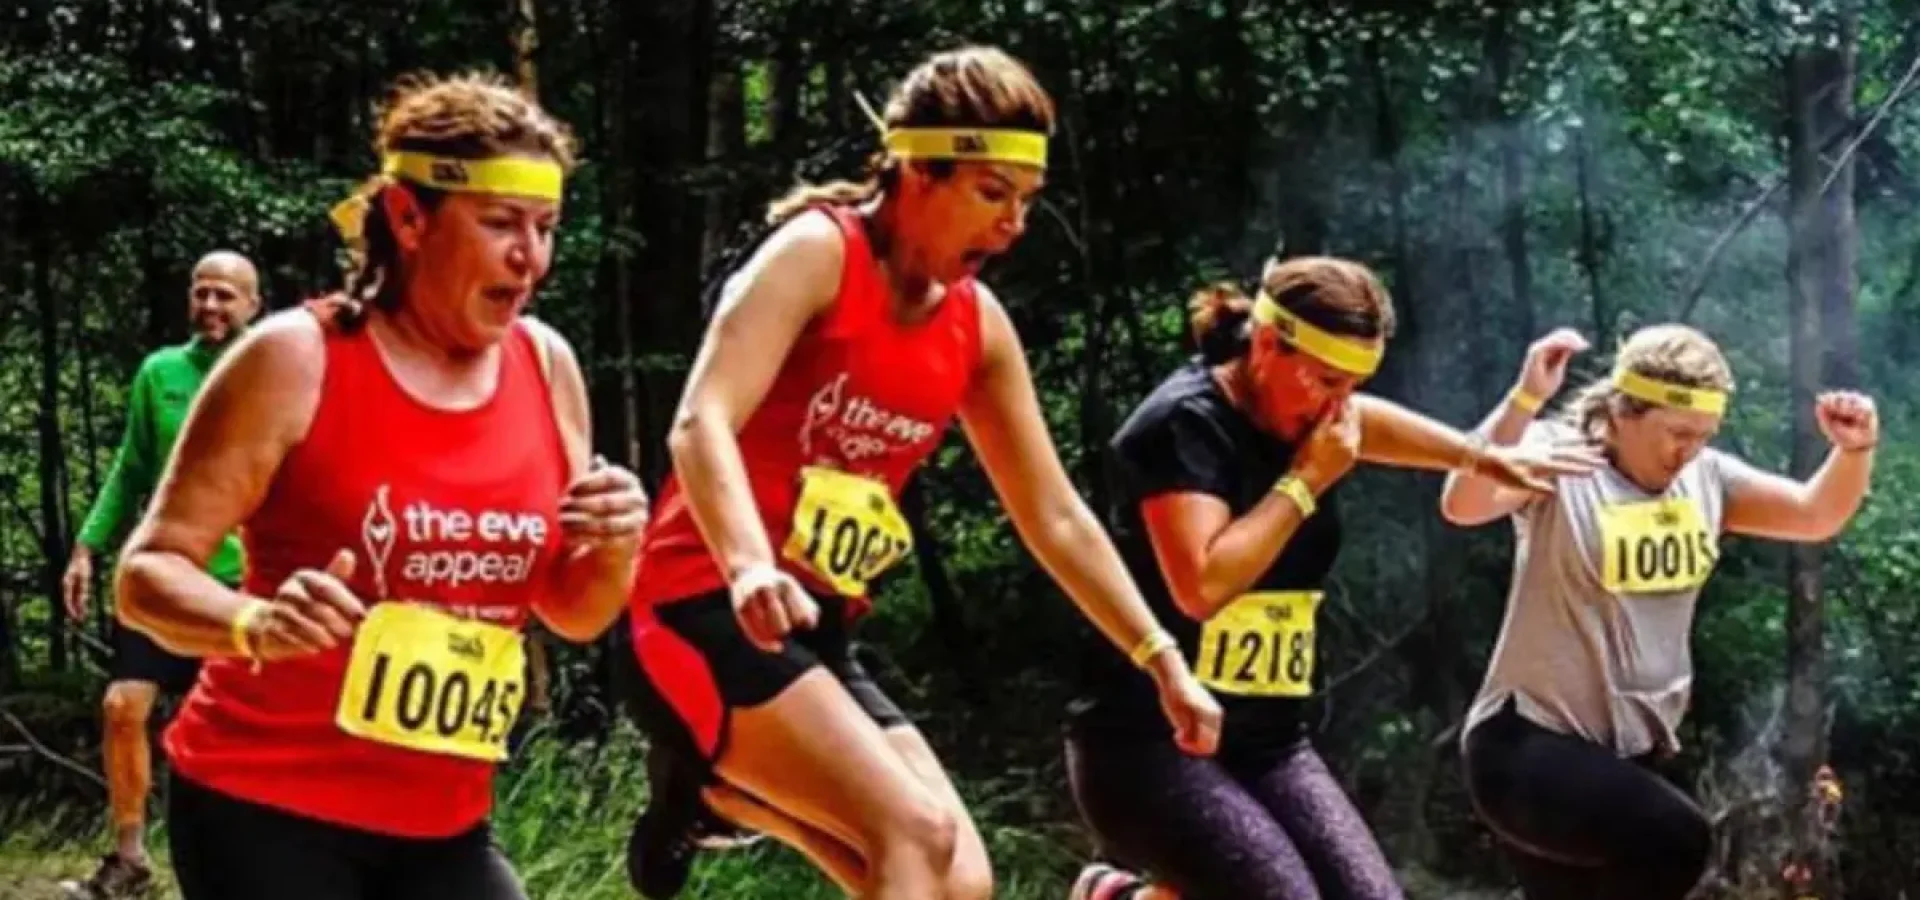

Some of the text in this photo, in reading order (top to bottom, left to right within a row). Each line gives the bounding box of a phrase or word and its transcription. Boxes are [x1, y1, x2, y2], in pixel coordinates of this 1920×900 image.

[403, 502, 547, 546] the eve
[403, 549, 536, 588] appeal
[1616, 531, 1714, 582] 10015
[361, 653, 519, 745] 10045
